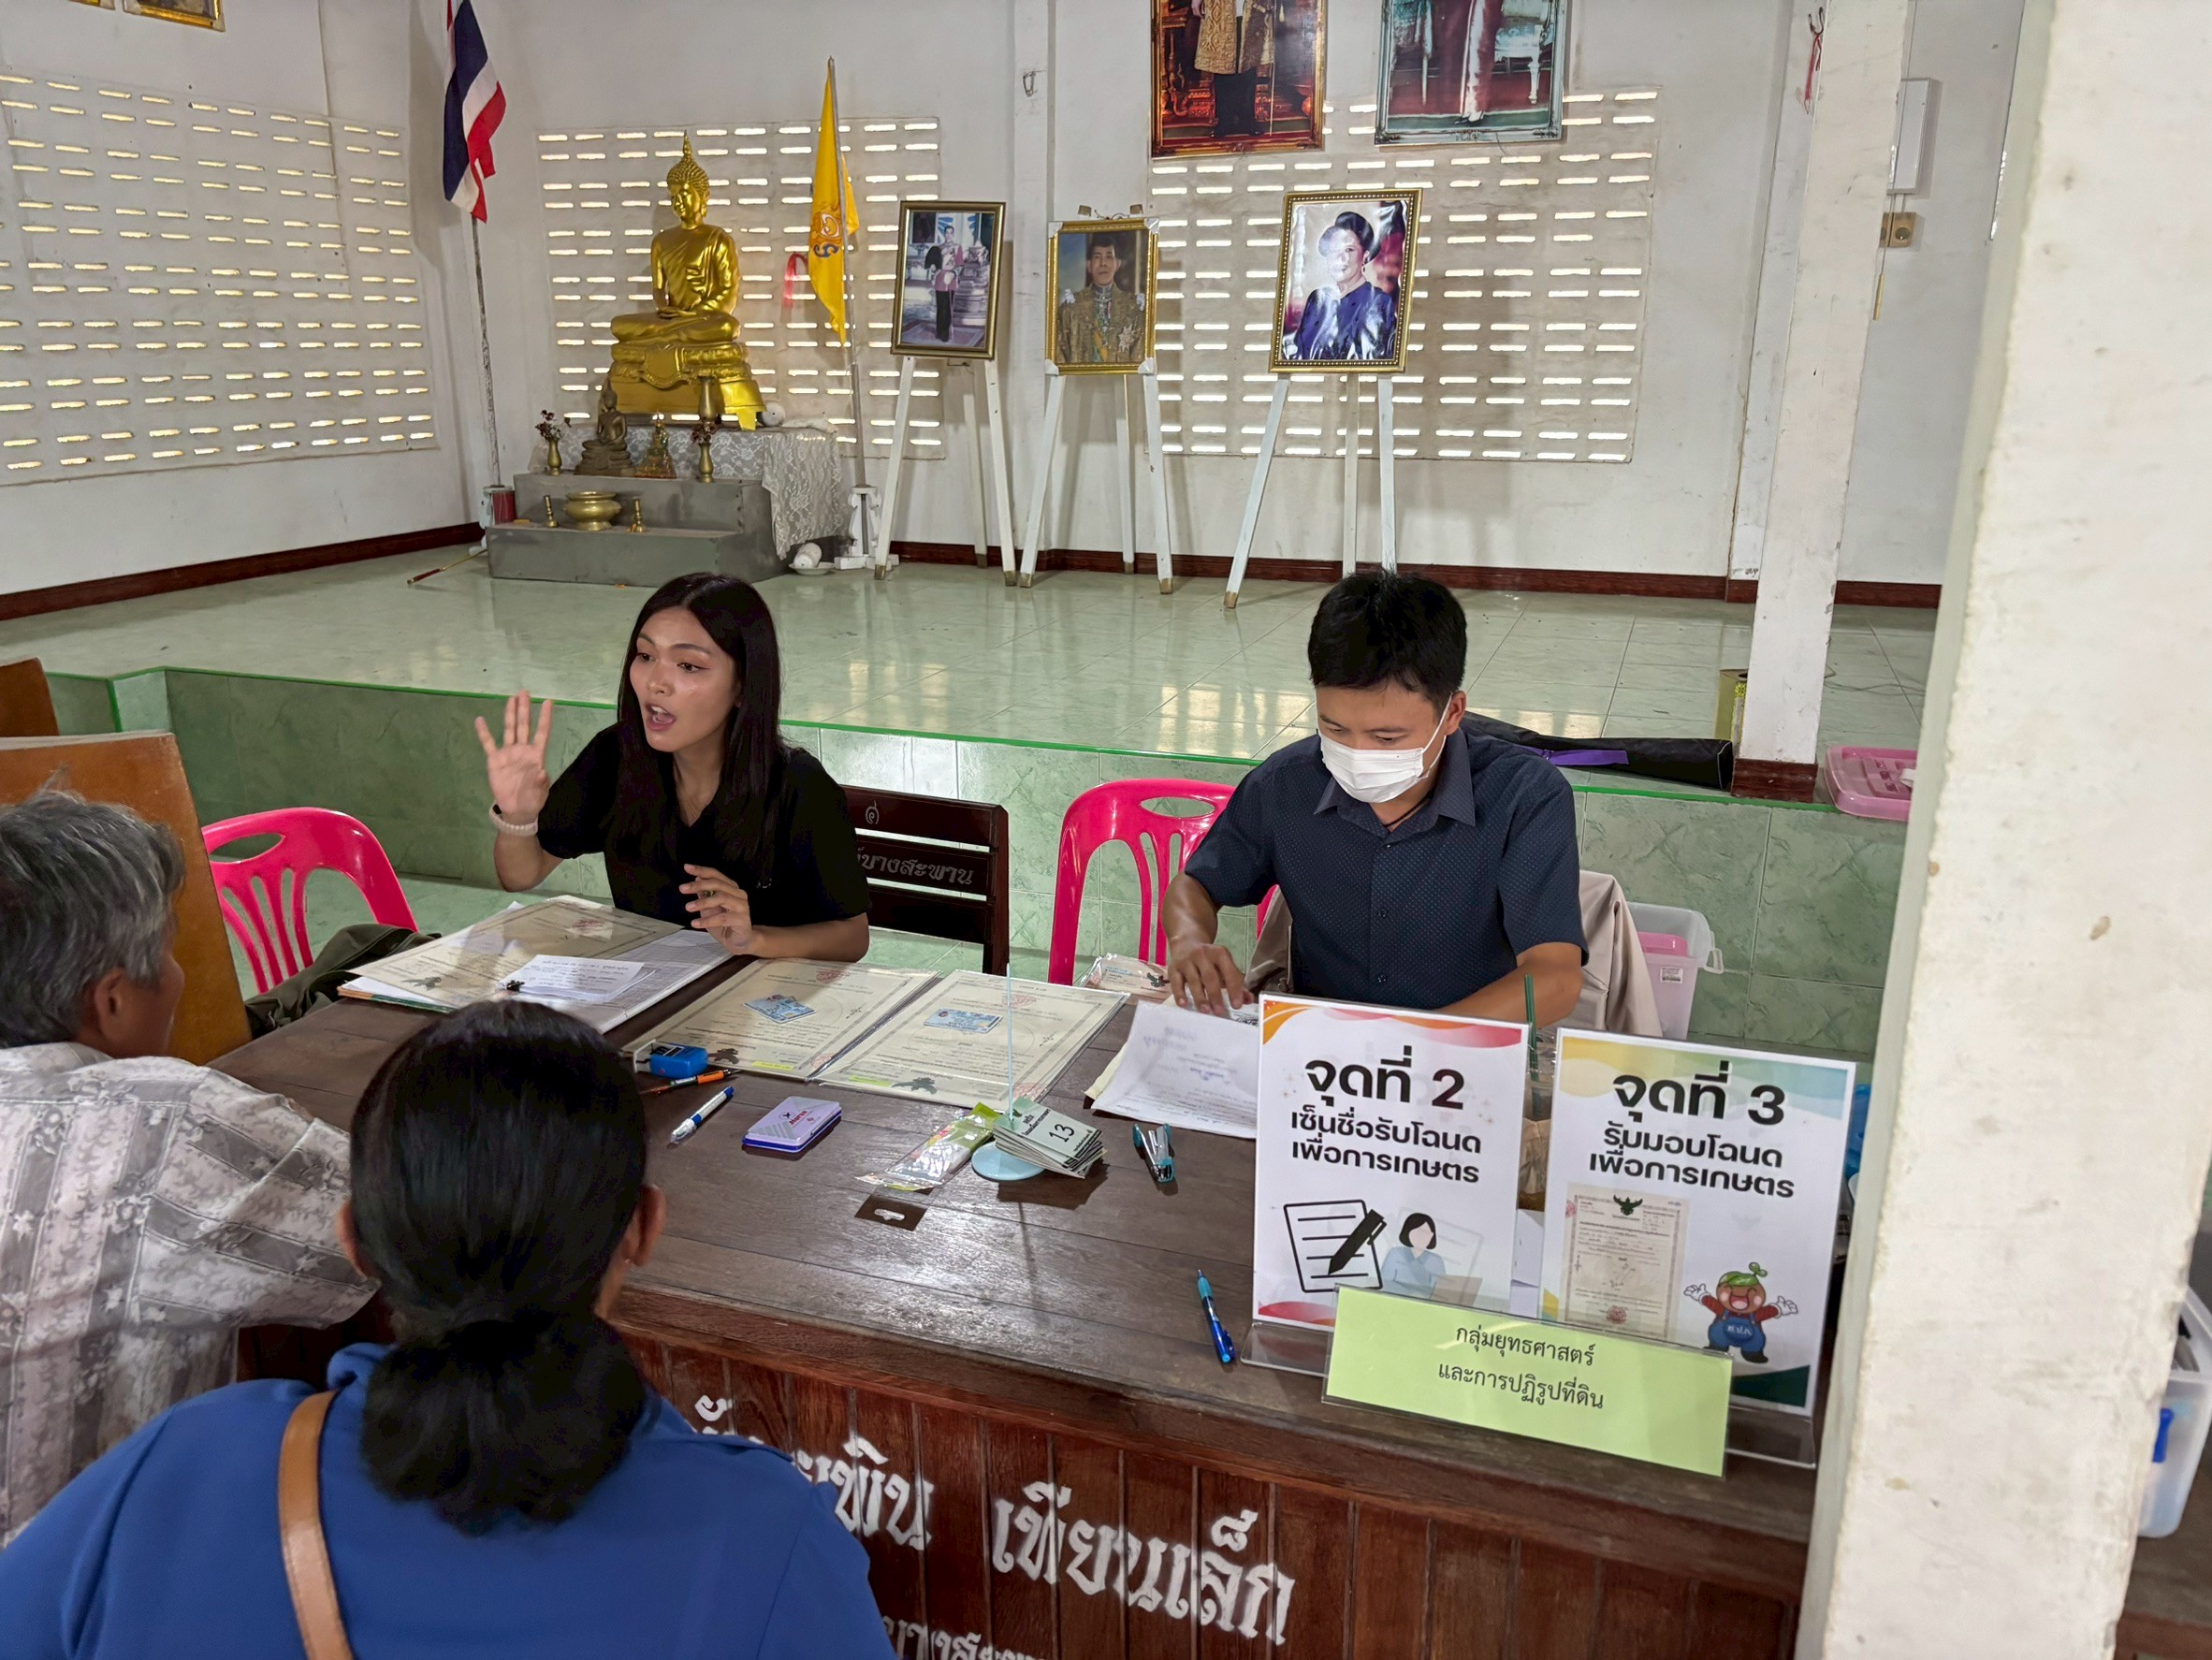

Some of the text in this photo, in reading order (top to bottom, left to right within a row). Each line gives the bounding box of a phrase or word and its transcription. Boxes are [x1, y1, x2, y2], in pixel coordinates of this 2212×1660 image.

[856, 847, 974, 885] บางสะพาน
[1304, 1045, 1413, 1107] จุดที่
[1431, 1069, 1465, 1110] 2
[1612, 1060, 1785, 1126] จุดที่ 3
[1048, 1123, 1075, 1143] 13
[1291, 1104, 1481, 1154] เซ็นชื่อรับโฉนด
[1603, 1121, 1783, 1169] รับมอบโฉนด
[1292, 1133, 1479, 1184] เพื่อการเกษตร
[1590, 1144, 1795, 1198] เพื่อการเกษตร
[1456, 1324, 1595, 1366] กลุ่มยุทธศาสตร์
[1438, 1363, 1604, 1409] และการปฏิรูปที่ดิน
[992, 1479, 1296, 1646] เทียนเล็ก
